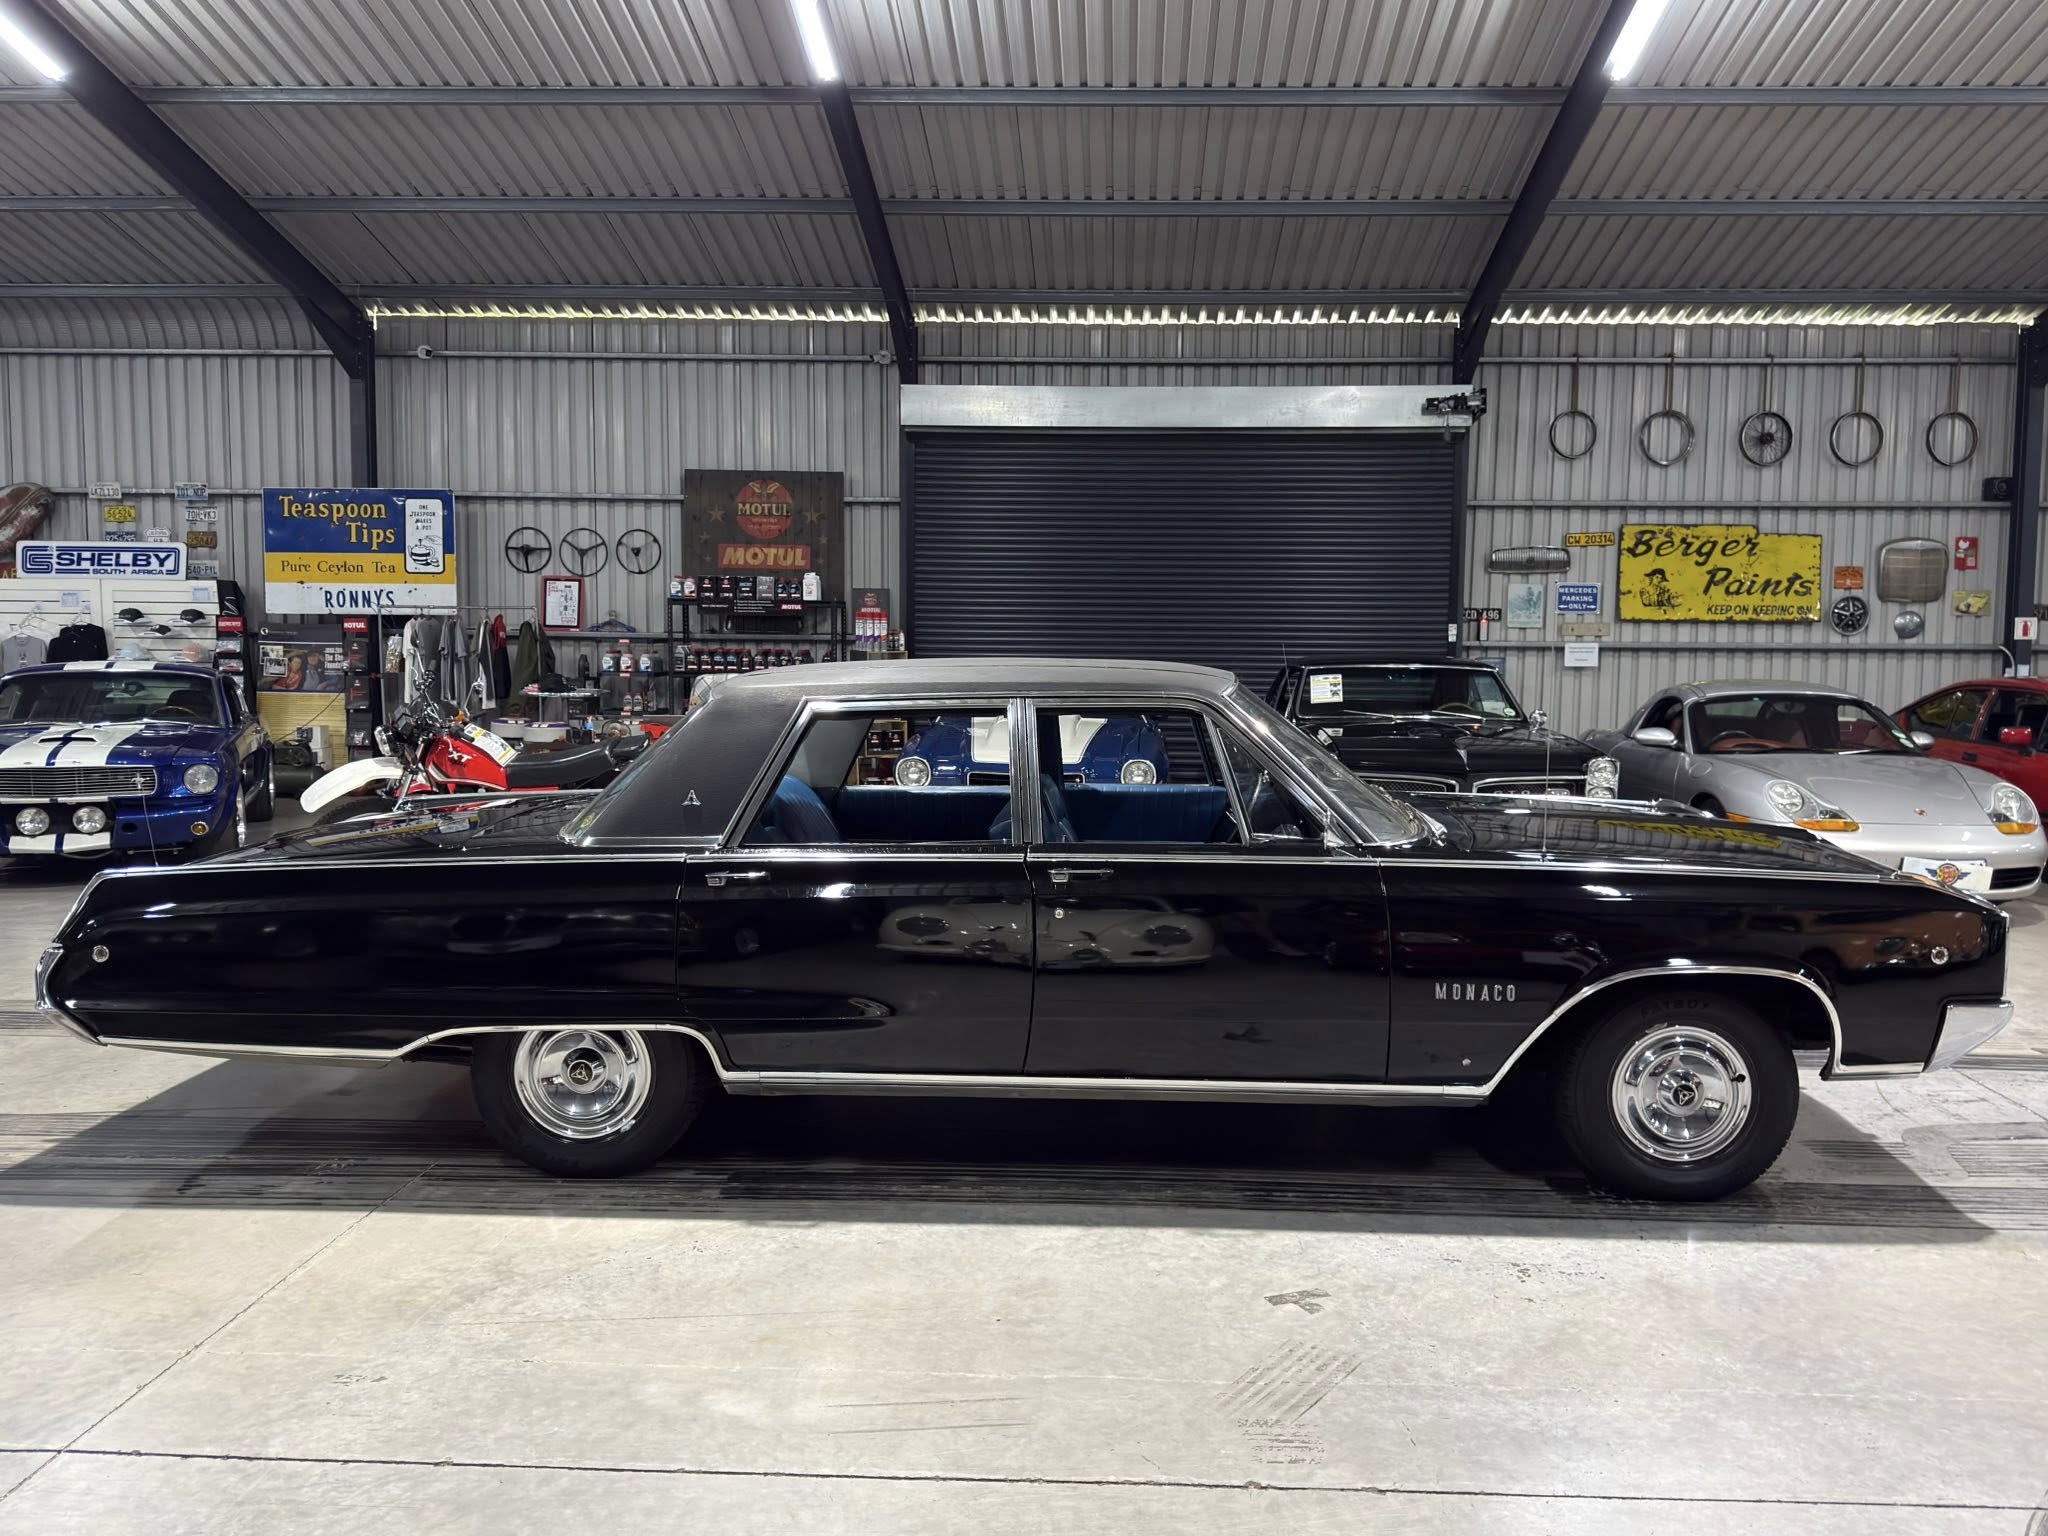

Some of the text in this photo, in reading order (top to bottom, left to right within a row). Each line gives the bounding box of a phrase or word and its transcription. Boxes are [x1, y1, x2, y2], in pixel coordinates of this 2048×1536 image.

[279, 496, 387, 527] Teaspoon
[737, 503, 791, 516] MOTUL
[345, 522, 397, 550] Tips
[1567, 534, 1613, 545] CW 20314
[723, 546, 806, 567] MOTUL
[1626, 529, 1760, 567] Berger
[56, 552, 174, 567] SHELBY
[281, 560, 396, 576] Pure Ceylon Tea
[1703, 567, 1814, 597] Paints
[325, 590, 395, 608] RONNYS
[1707, 605, 1733, 615] KEEP
[1735, 605, 1749, 615] ON
[1435, 982, 1516, 1002] MONACO
